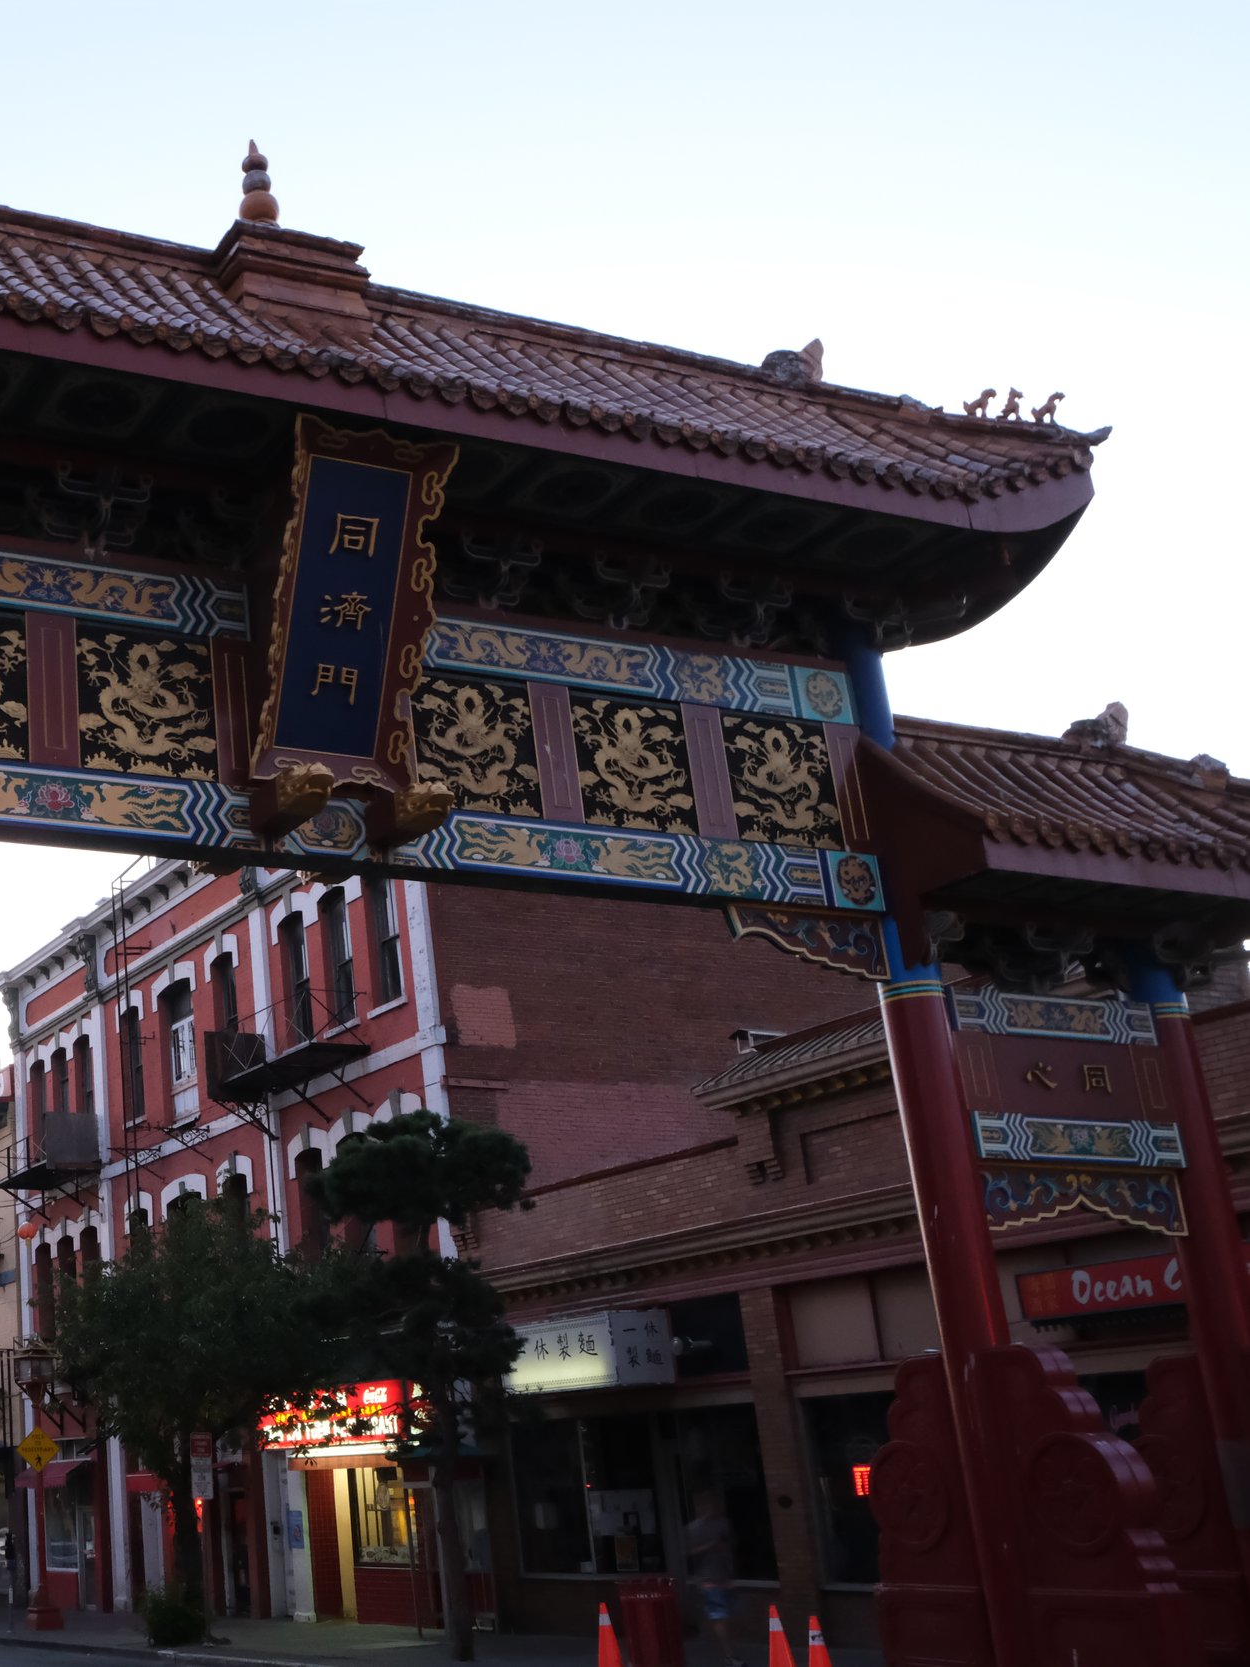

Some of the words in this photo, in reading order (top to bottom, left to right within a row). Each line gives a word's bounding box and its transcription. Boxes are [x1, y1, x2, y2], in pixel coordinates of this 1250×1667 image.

[310, 512, 381, 706] 同濟門
[1070, 1269, 1153, 1305] Ocean
